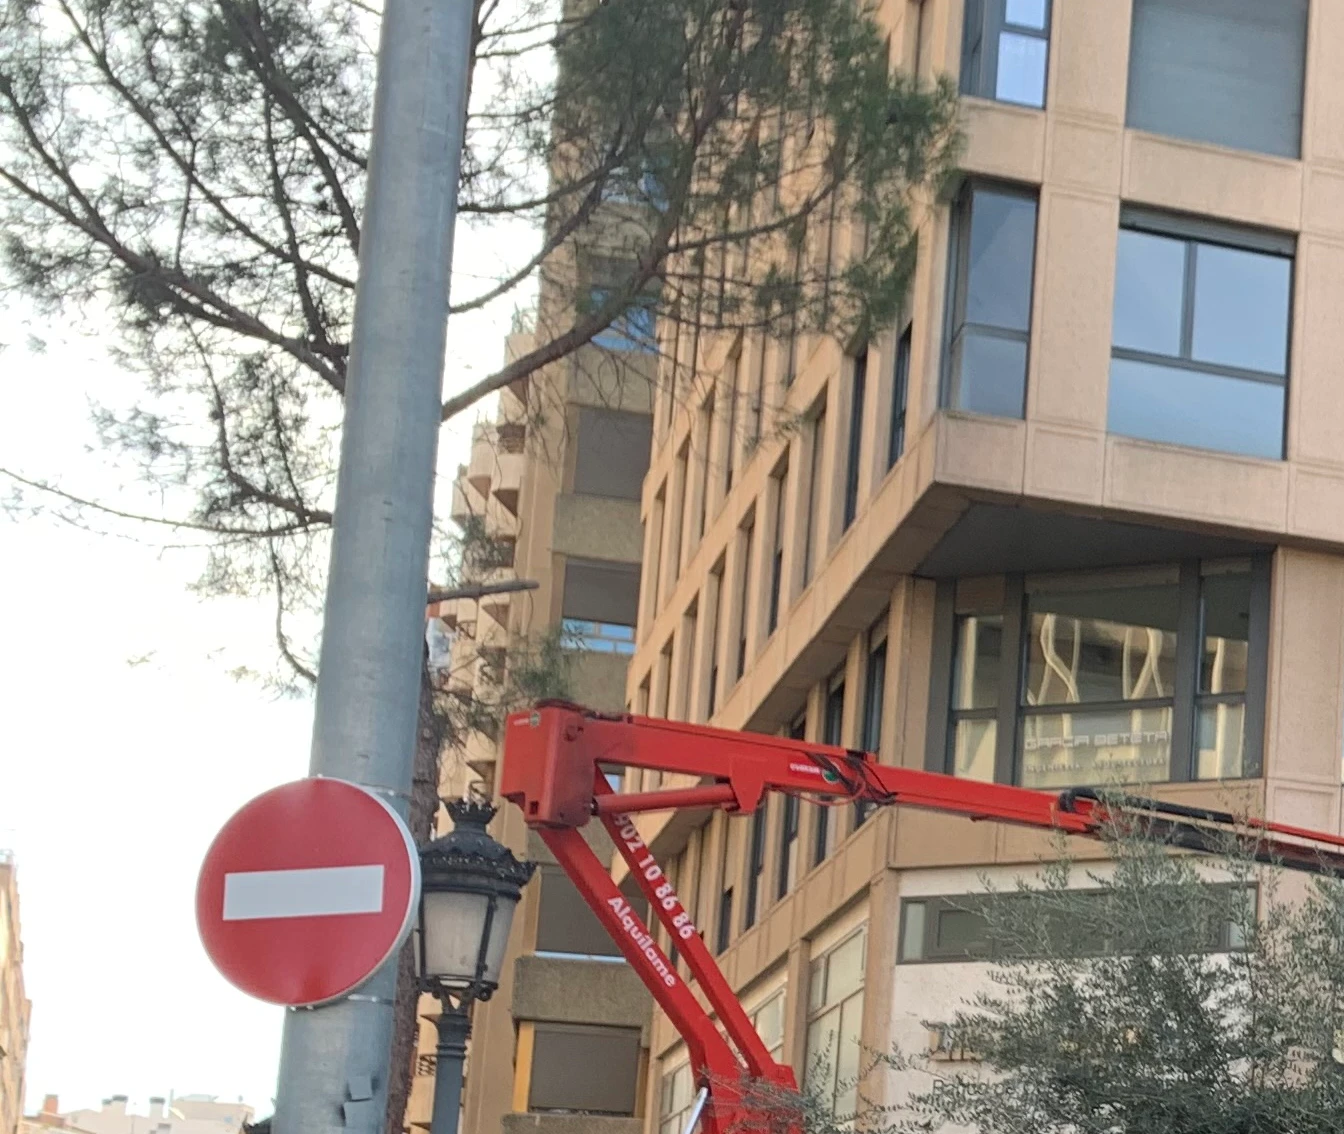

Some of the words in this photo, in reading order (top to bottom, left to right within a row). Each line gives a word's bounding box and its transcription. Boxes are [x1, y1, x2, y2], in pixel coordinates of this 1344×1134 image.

[614, 812, 644, 853] 902
[639, 854, 662, 881] 10
[655, 882, 679, 910] 86
[672, 911, 696, 940] 86
